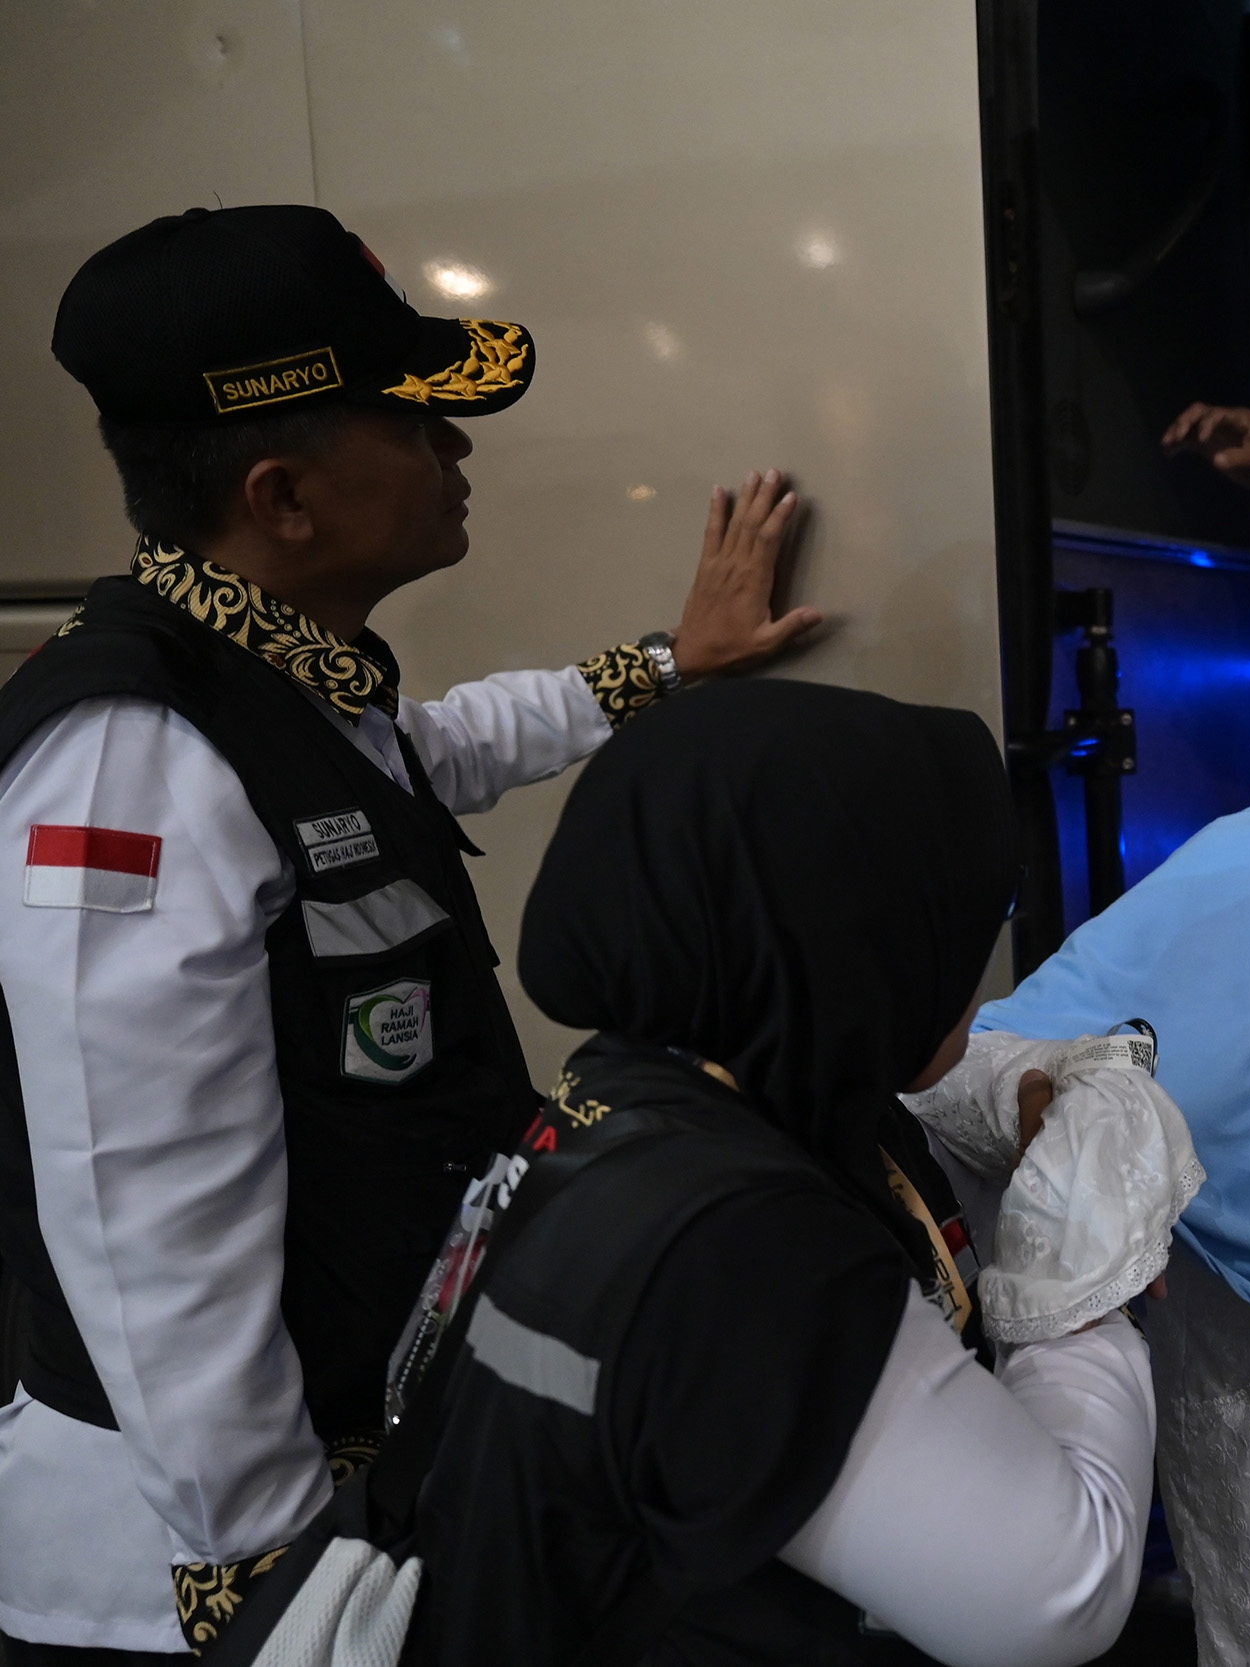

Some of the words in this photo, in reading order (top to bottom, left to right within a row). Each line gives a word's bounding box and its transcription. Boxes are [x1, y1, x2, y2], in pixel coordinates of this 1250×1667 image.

[222, 362, 328, 400] SUNARYO
[311, 814, 361, 840] SUNARYO
[313, 849, 341, 867] PETUGAS
[390, 1006, 414, 1020] HAJI
[381, 1017, 419, 1034] RAMAH
[381, 1030, 418, 1046] LANSIA
